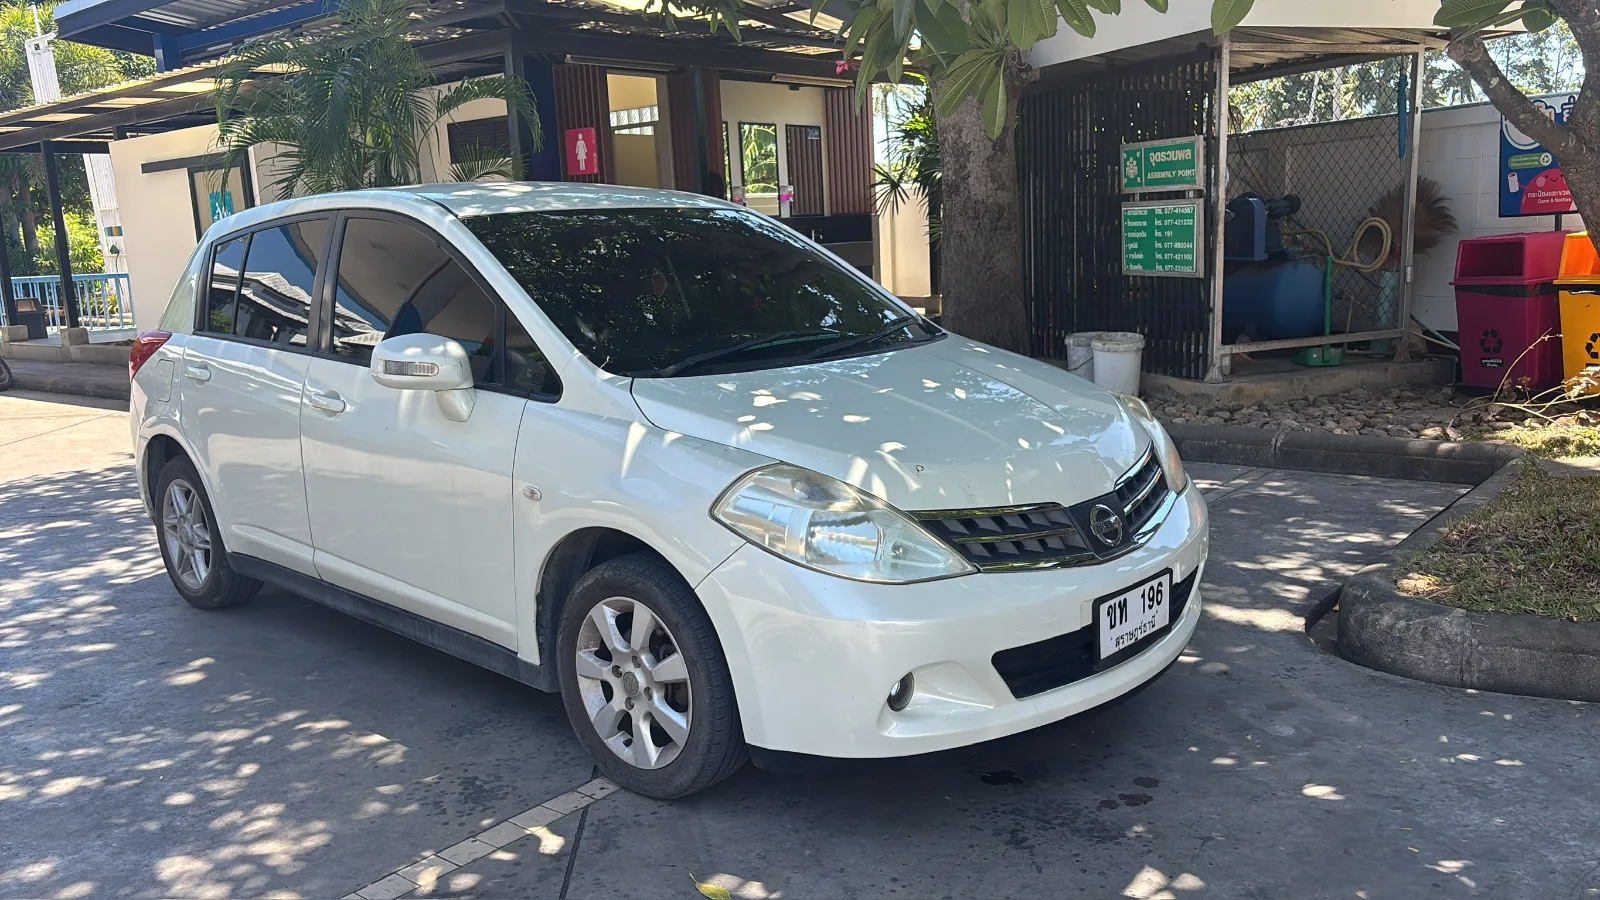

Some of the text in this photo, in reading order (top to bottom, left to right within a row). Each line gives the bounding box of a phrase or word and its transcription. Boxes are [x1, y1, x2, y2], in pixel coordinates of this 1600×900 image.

[1149, 149, 1192, 167] จุดรวมพล
[1147, 169, 1195, 179] ASSEMBLY POINT
[1106, 581, 1163, 631] ขท 196
